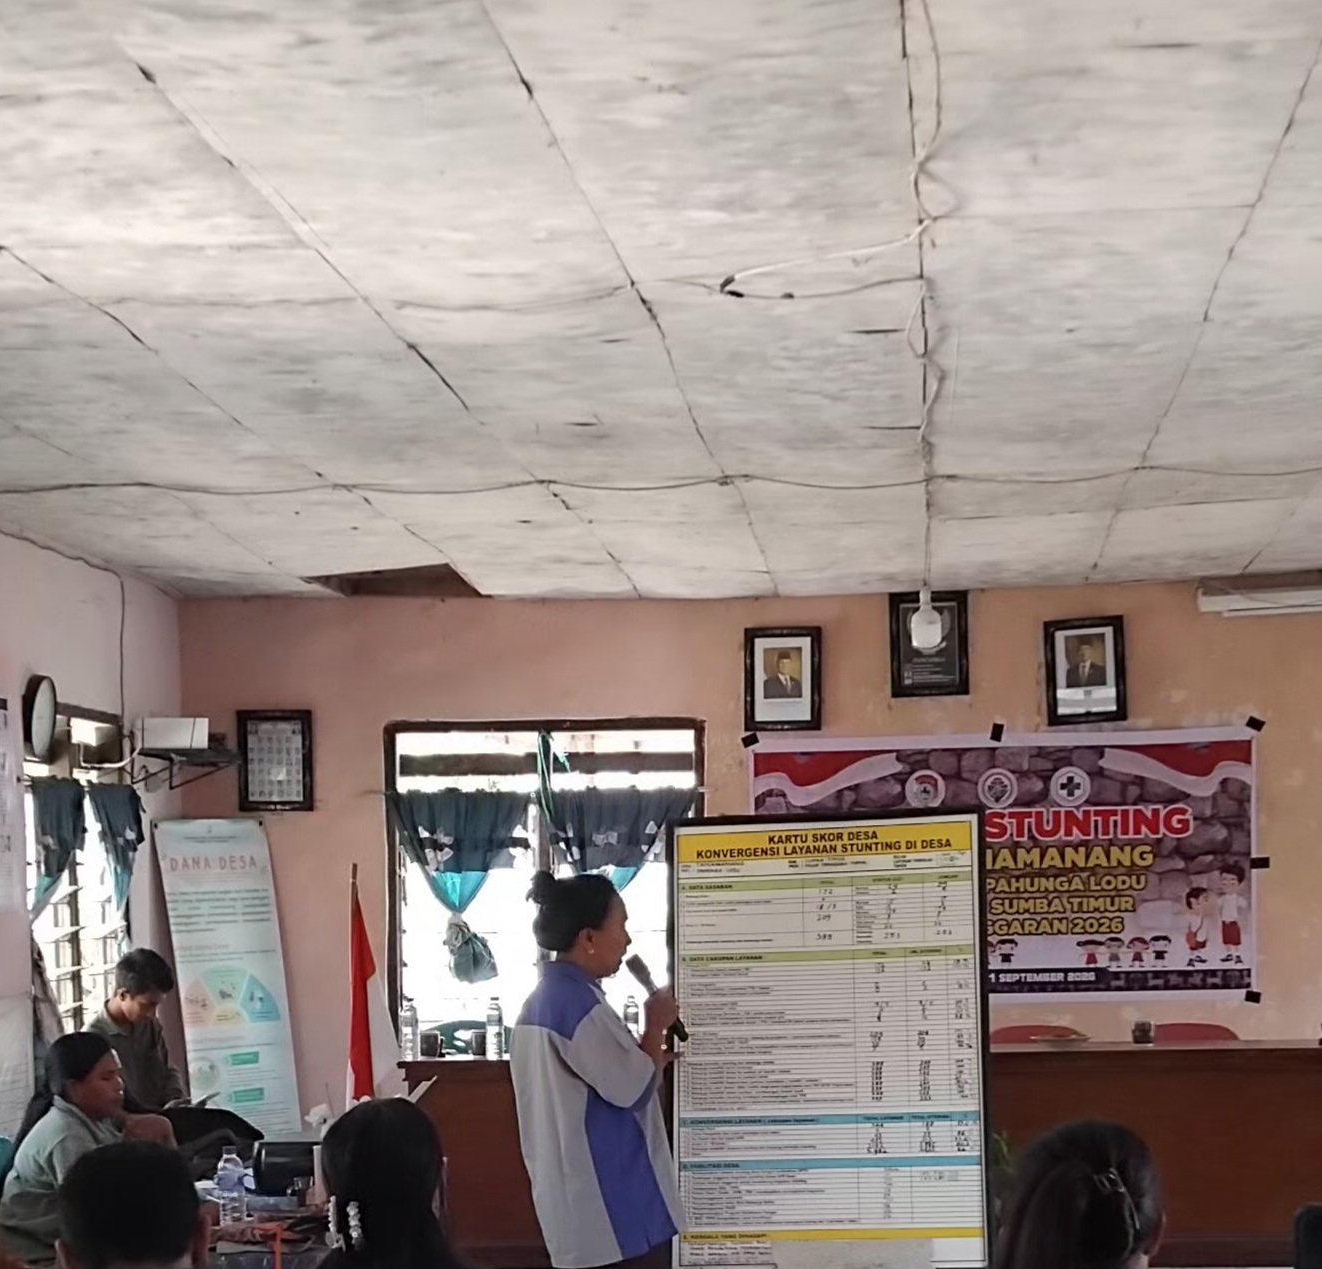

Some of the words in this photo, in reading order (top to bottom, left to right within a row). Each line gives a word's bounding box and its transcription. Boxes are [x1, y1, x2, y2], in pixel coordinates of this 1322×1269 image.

[985, 807, 1192, 840] STUNTING
[768, 834, 808, 845] KARTU
[811, 832, 844, 843] SKOR
[847, 830, 878, 841] DESA
[696, 846, 780, 859] KONVERGENSI
[783, 843, 837, 856] LAYANAN
[841, 841, 902, 853] STUNTING
[905, 840, 917, 850] DI
[921, 838, 952, 849] DESA
[170, 856, 211, 871] DANA
[219, 854, 257, 870] DESA
[986, 876, 1084, 893] PAHUNGA
[1090, 874, 1146, 890] LODU
[990, 897, 1064, 914] SUMBA
[1070, 896, 1135, 912] TIMUR
[1072, 916, 1124, 933] 2026
[999, 973, 1064, 983] SEPTEMBER
